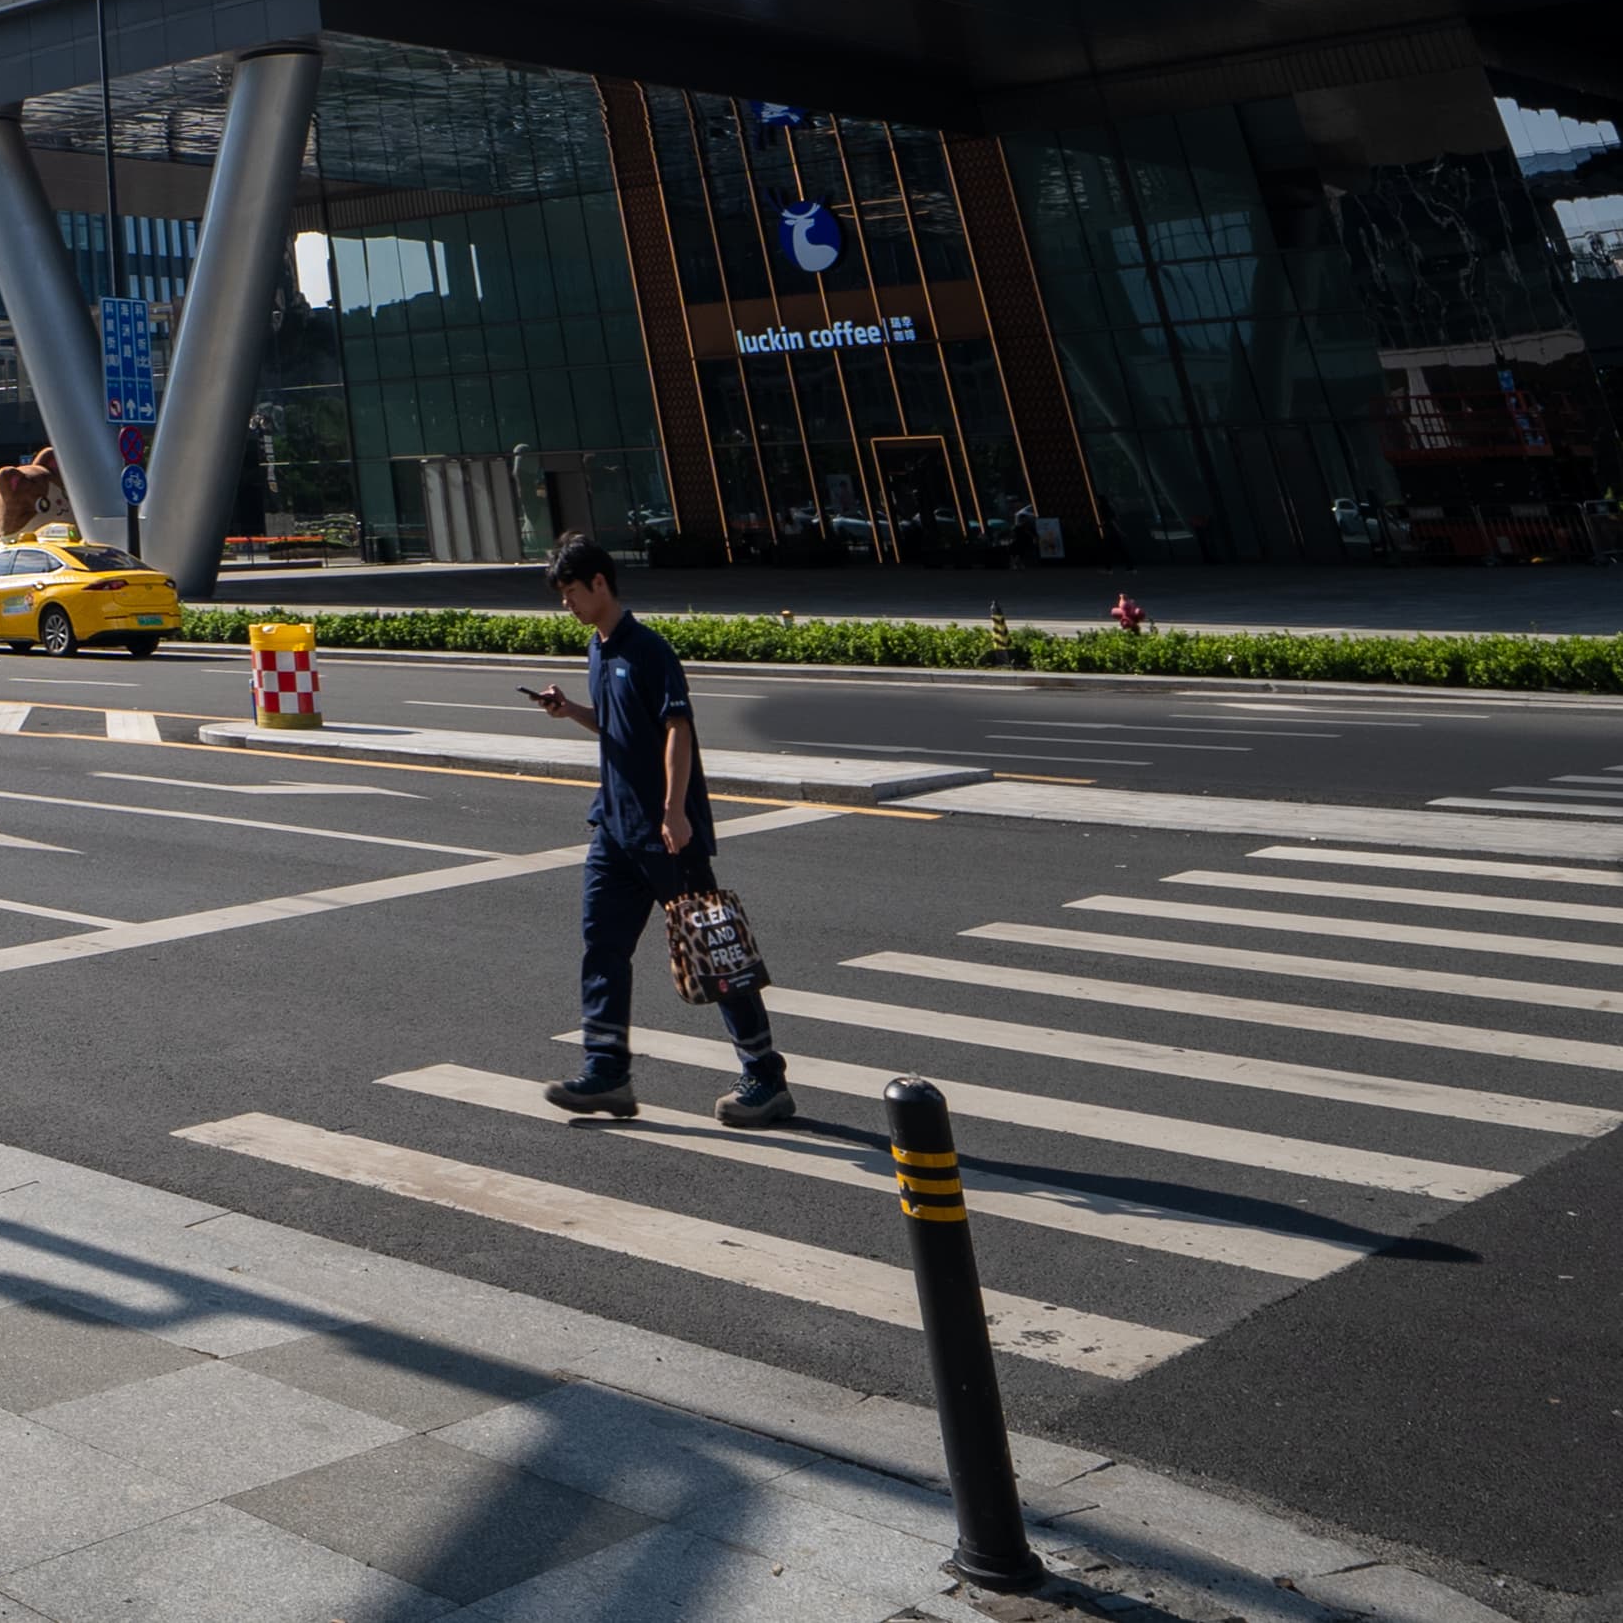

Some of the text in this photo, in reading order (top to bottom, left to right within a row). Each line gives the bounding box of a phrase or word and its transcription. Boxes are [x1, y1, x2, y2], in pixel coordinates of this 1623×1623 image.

[736, 321, 882, 353] luckin coffee
[692, 905, 737, 928] CLEAN
[708, 925, 735, 947] AND
[711, 944, 744, 967] FREE
